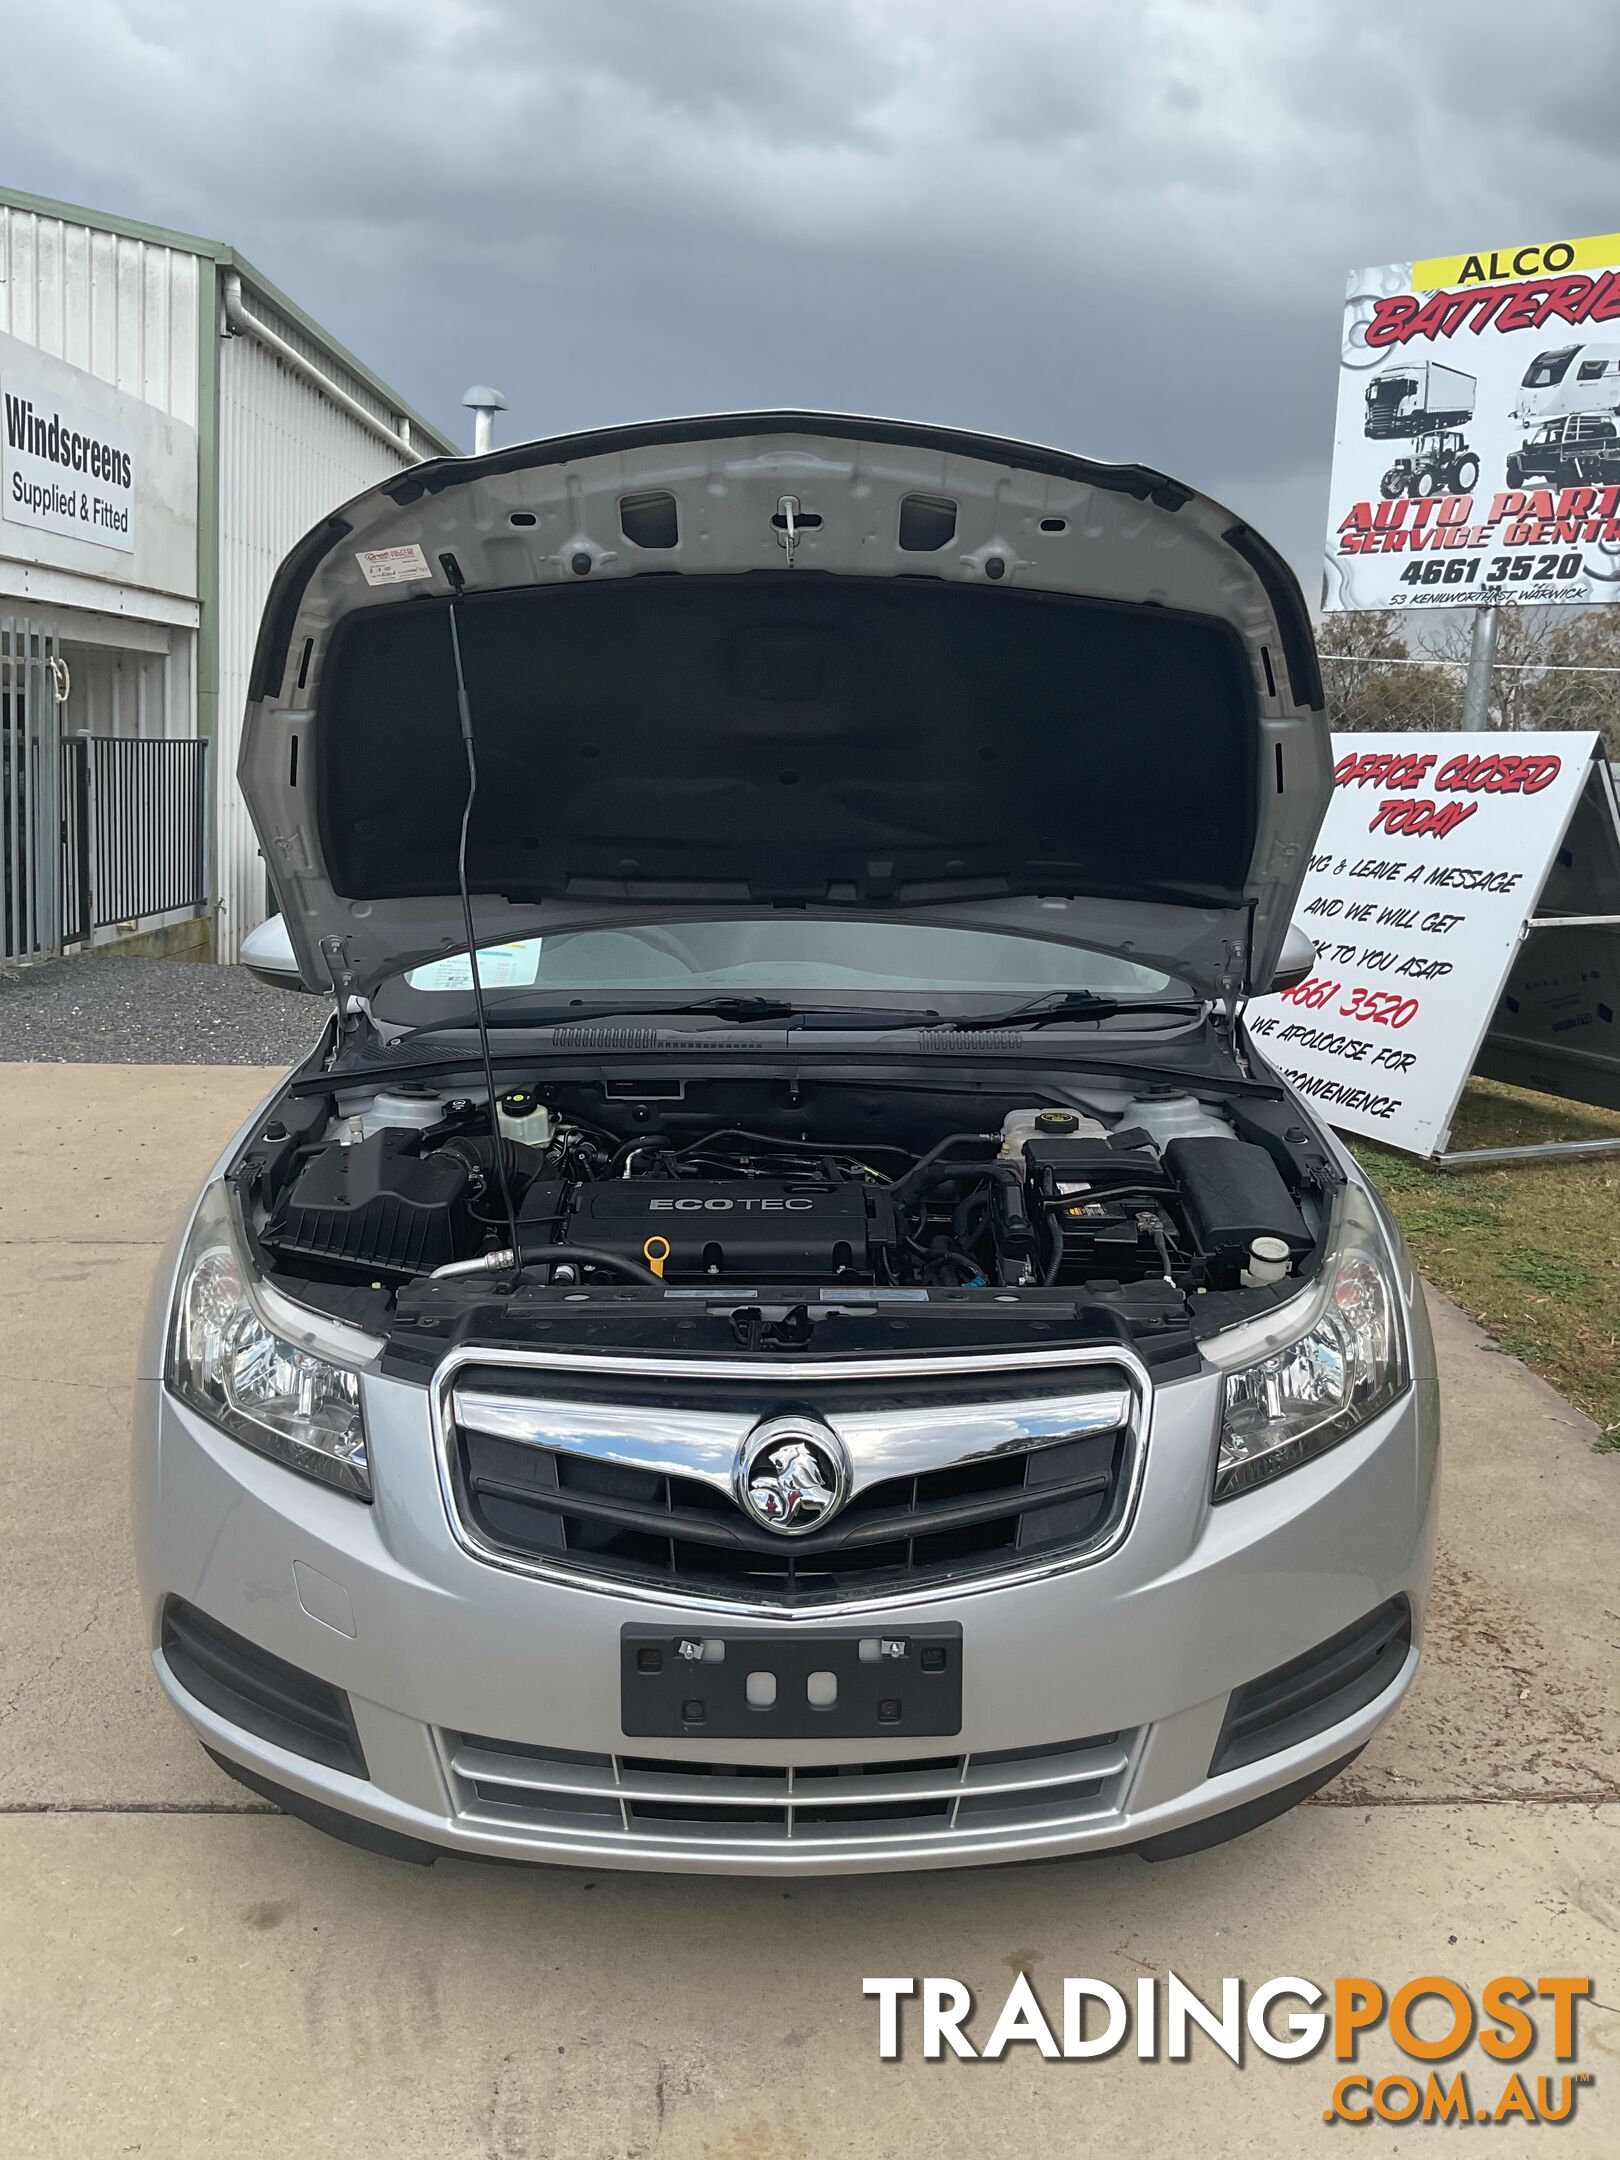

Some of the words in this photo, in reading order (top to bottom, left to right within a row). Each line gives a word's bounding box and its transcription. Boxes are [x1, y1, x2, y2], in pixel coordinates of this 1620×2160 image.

[1458, 243, 1575, 284] ALCO
[5, 392, 132, 489] Windscreens
[12, 471, 76, 517] Supplied
[80, 493, 89, 522] &
[93, 497, 128, 533] Fitted
[1336, 495, 1474, 534] AUTO
[1337, 526, 1495, 555] SERVICE
[1400, 557, 1483, 586] 4661
[1486, 553, 1584, 582] 3520
[1389, 594, 1408, 606] 53
[1410, 589, 1494, 605] KENILWORTH
[1498, 590, 1518, 601] ST
[1518, 588, 1589, 600] WARWICK
[1334, 752, 1438, 790] OFFICE
[1435, 753, 1562, 795] CLOSED
[1369, 799, 1478, 840] TODAY
[1333, 858, 1347, 876] &
[1349, 859, 1407, 881] LEAVE
[1404, 864, 1425, 883] A
[1424, 866, 1523, 893] MESSAGE
[1303, 897, 1344, 917] AND
[1344, 902, 1378, 922] WE
[1376, 906, 1420, 929] WILL
[1421, 912, 1466, 934] GET
[1331, 945, 1357, 964] TO
[1357, 949, 1399, 971] YOU
[1395, 956, 1453, 980] ASAP
[1340, 988, 1419, 1029] 3520
[1250, 1016, 1280, 1036] WE
[1277, 1024, 1374, 1061] APOLOGISE
[1371, 1048, 1416, 1074] FOR
[649, 1198, 813, 1211] ECOTEC
